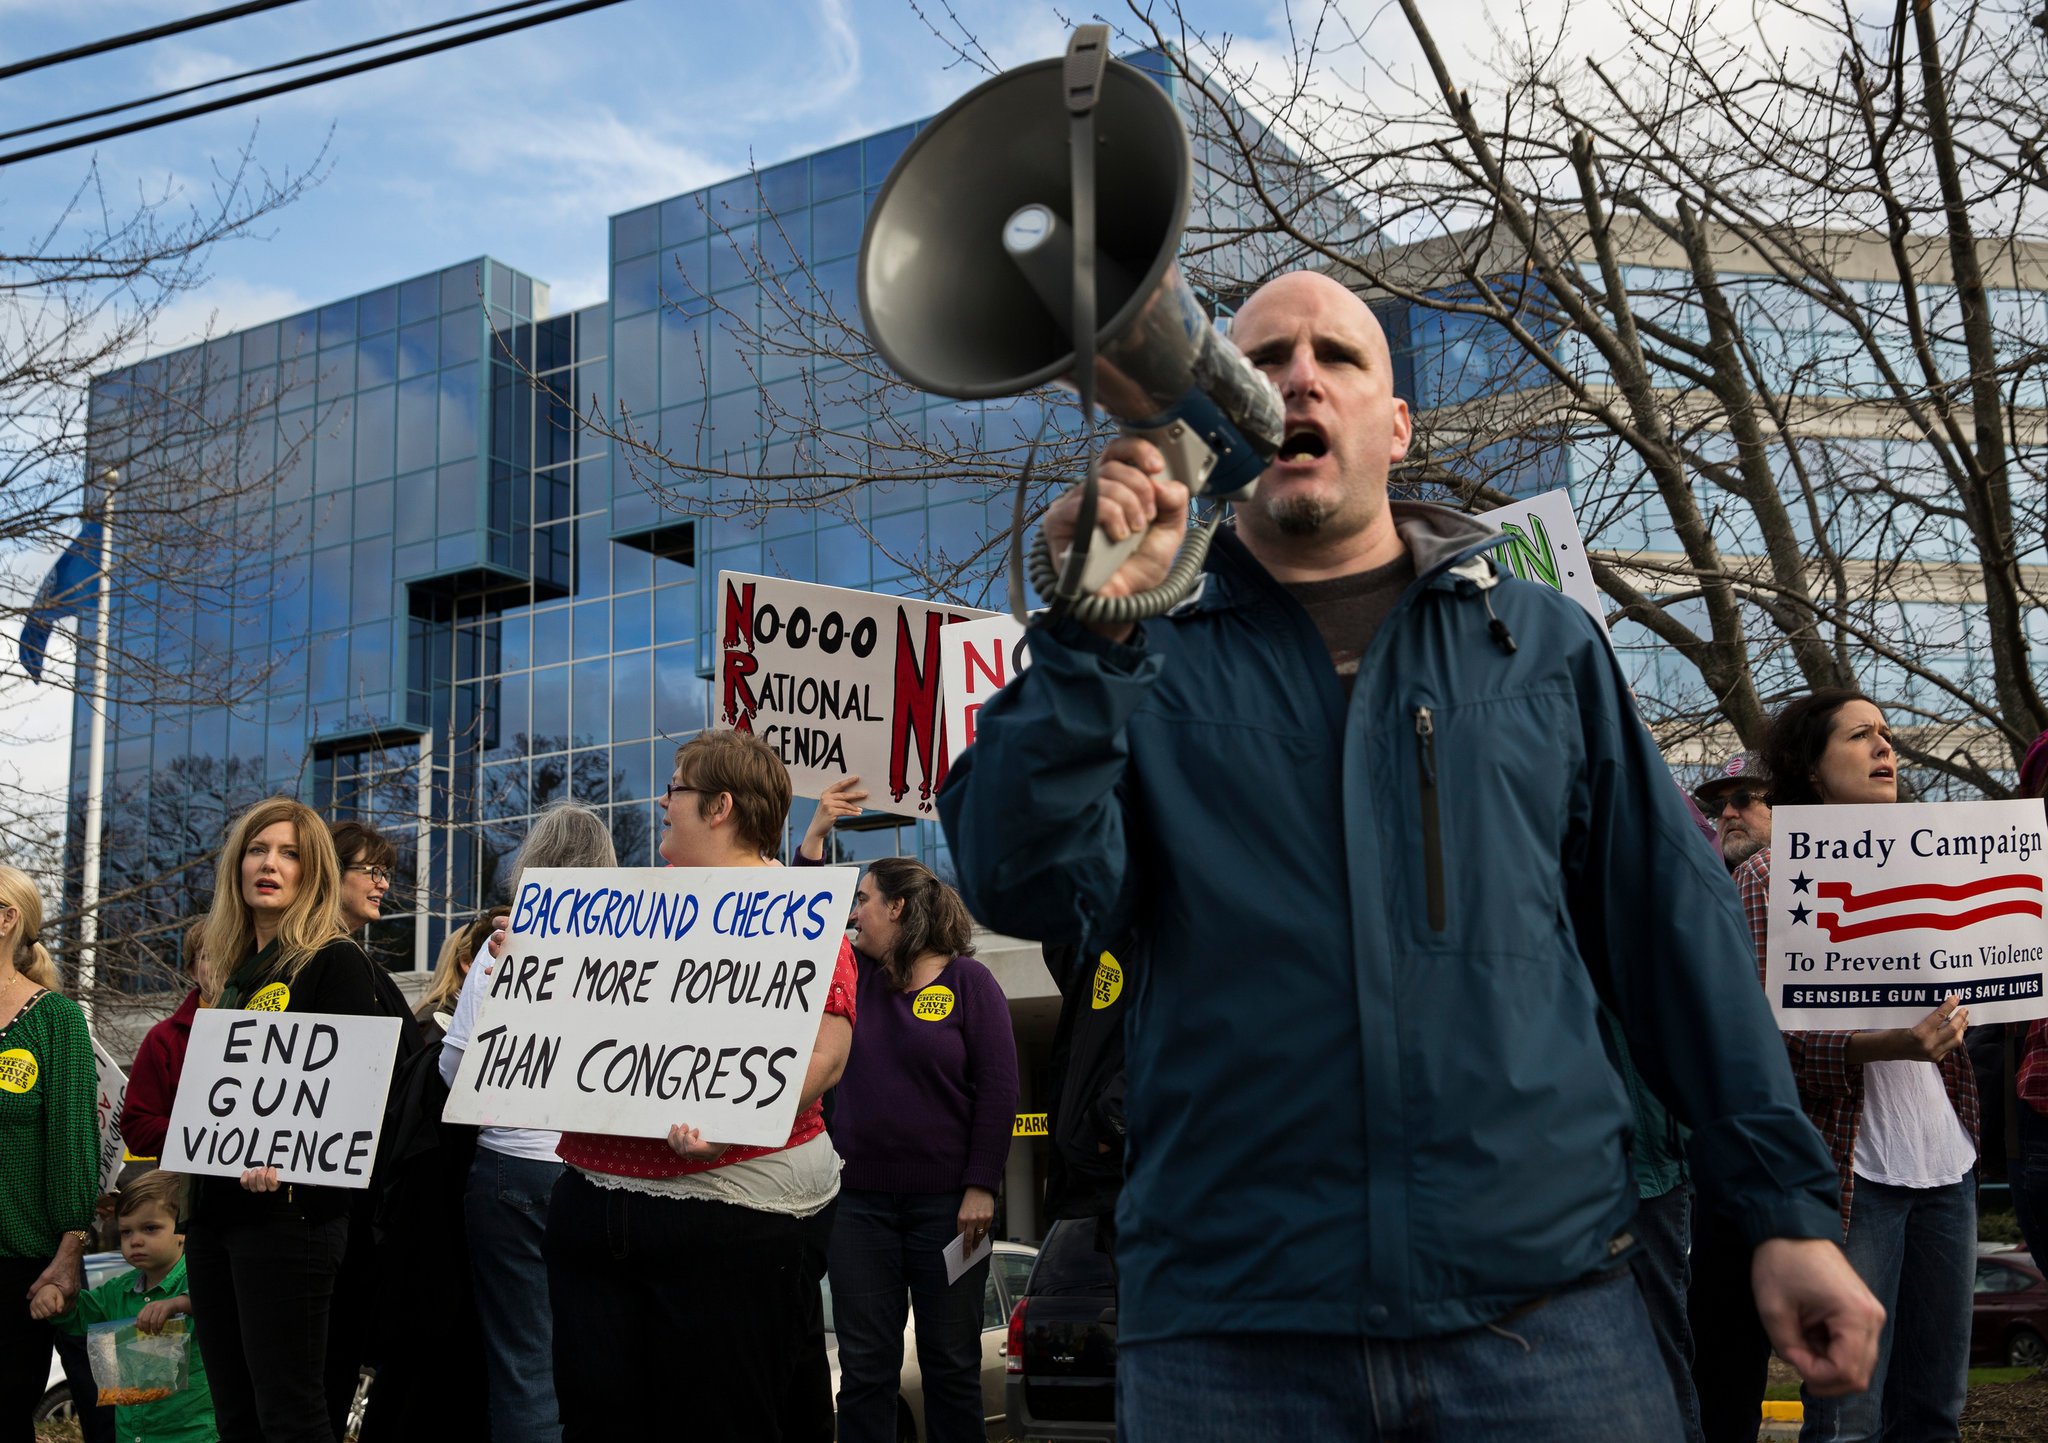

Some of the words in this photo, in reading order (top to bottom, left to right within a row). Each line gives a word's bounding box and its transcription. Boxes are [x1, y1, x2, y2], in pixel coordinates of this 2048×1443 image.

[723, 650, 884, 725] RATIONAL
[1788, 830, 1896, 868] Brady
[1910, 825, 2043, 864] Campaign
[511, 882, 699, 942] BACKGROUND
[713, 890, 833, 941] CHECKS
[1785, 952, 1815, 972] To
[1824, 952, 1921, 972] Prevent
[1929, 949, 1973, 970] Gun
[1979, 944, 2043, 966] Violence
[490, 954, 564, 1002] ARE
[572, 956, 659, 1006] MORE
[670, 958, 817, 1012] POPULAR
[1793, 990, 1880, 1003] SENSIBLE
[1888, 990, 1926, 1002] GUN
[1933, 987, 1972, 1002] LAWS
[1975, 982, 2005, 998] SAVE
[2009, 980, 2039, 996] LIVES
[223, 1019, 339, 1072] END
[474, 1024, 562, 1093] THAN
[576, 1038, 798, 1109] CONGRESS
[0, 1073, 28, 1090] IVES
[208, 1076, 331, 1119] GUN
[1016, 1116, 1048, 1133] PARK
